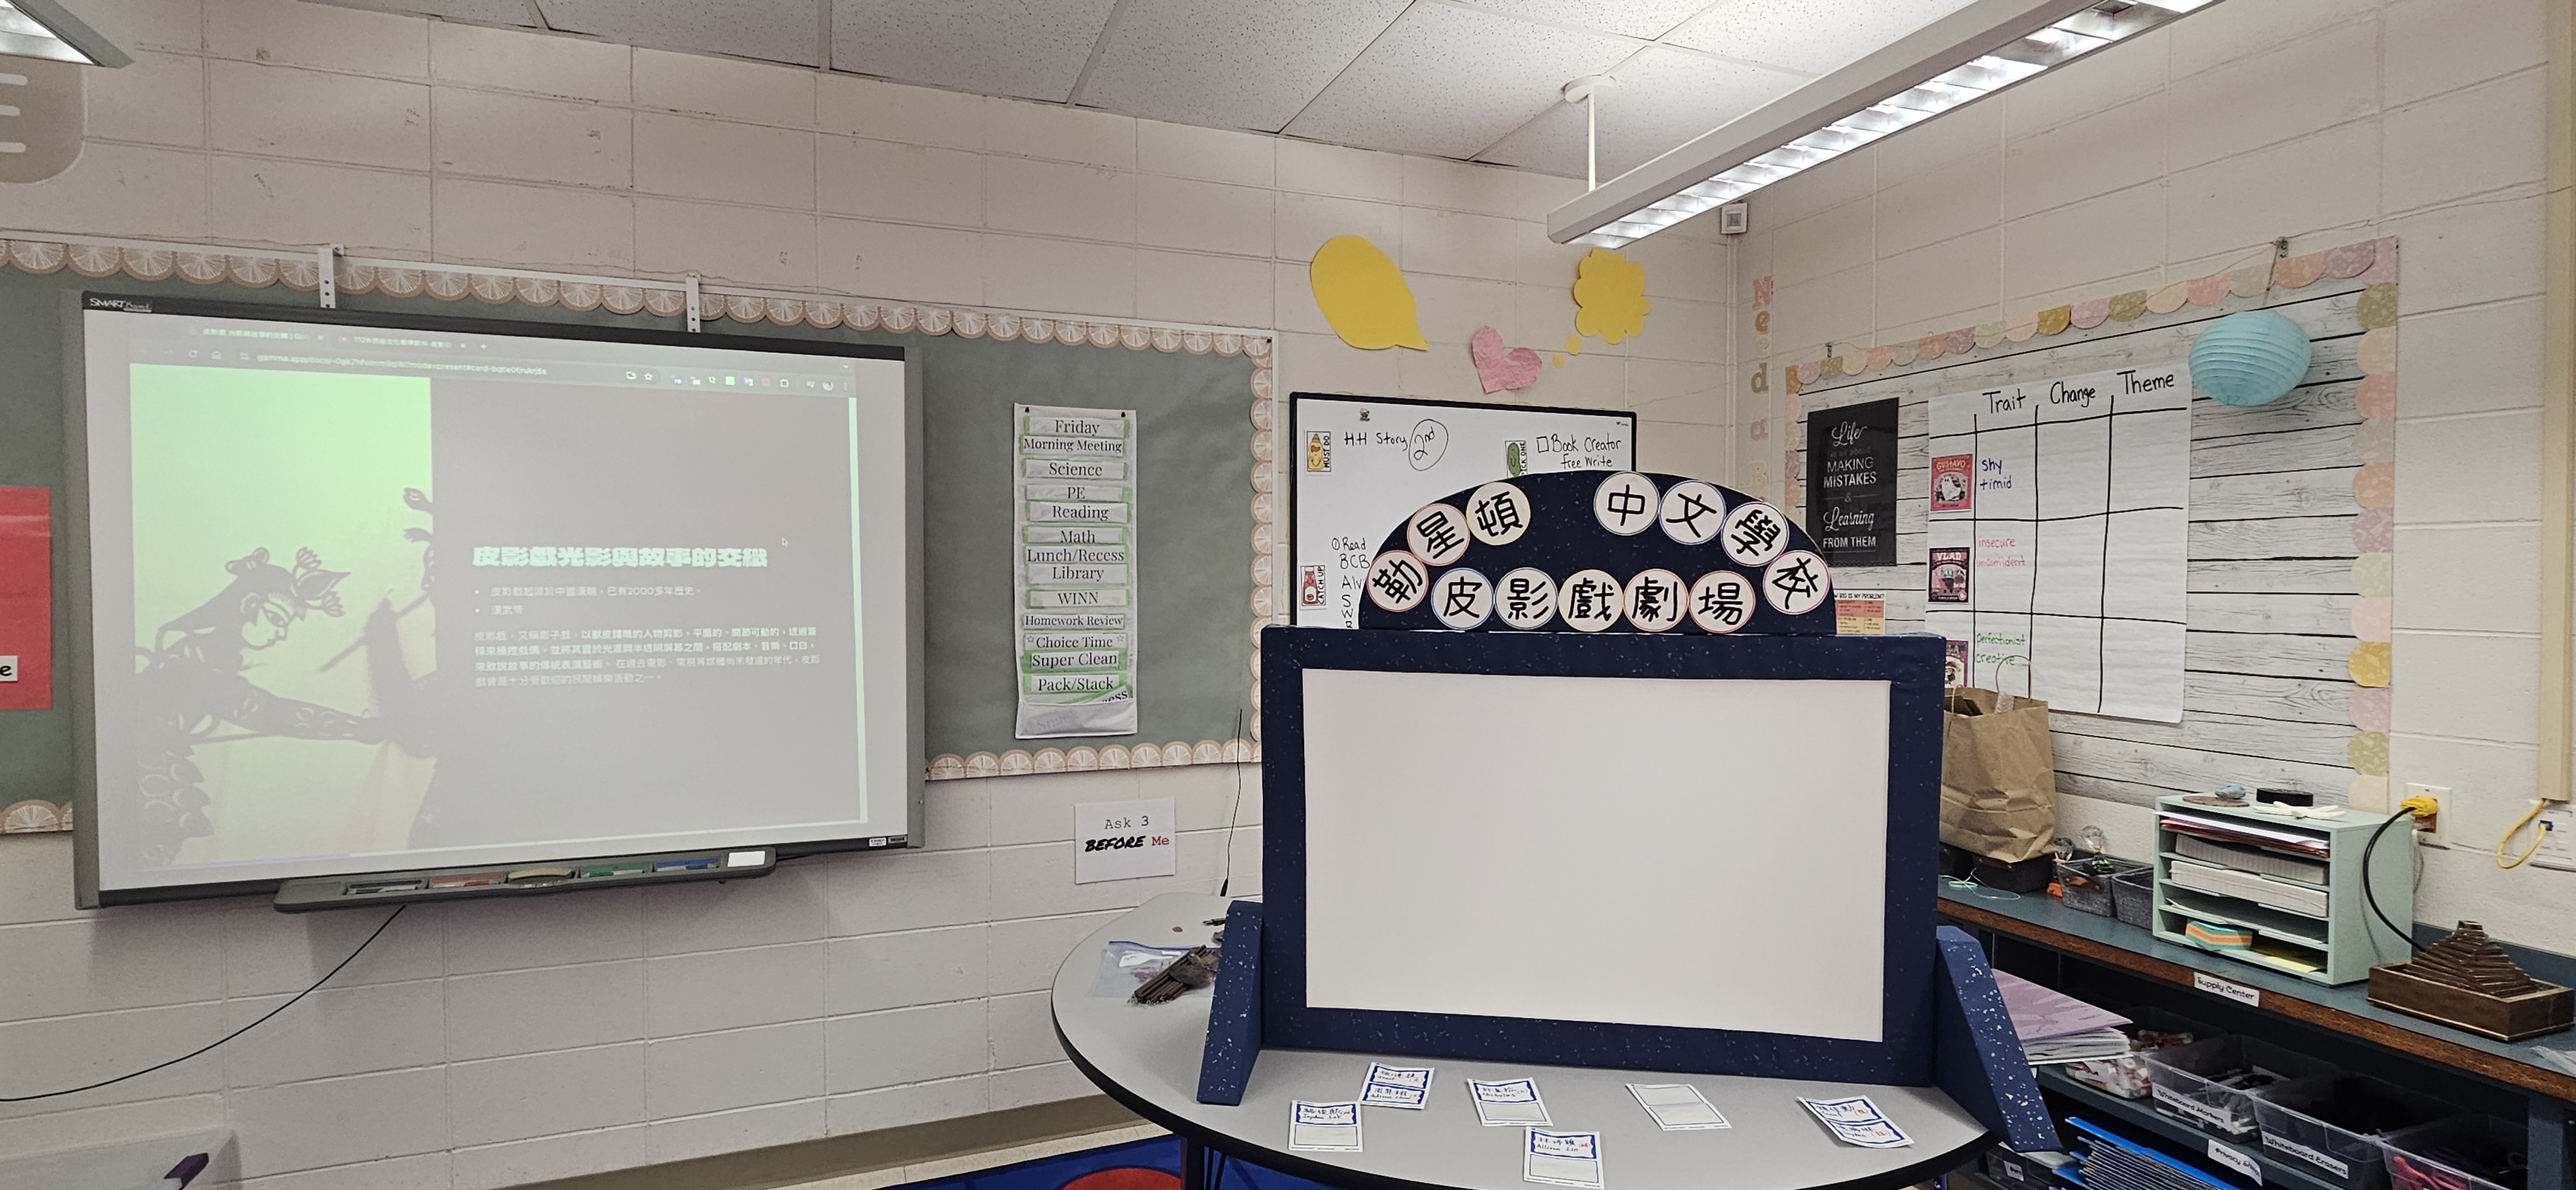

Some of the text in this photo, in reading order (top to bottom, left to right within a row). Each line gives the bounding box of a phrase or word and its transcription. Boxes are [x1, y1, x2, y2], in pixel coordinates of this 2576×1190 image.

[90, 298, 126, 308] SMART
[1982, 370, 2175, 414] Trait Change Theme
[1055, 419, 1100, 437] Friday
[1831, 420, 1868, 446] Life
[1024, 438, 1122, 453] Morning Meeting
[1323, 435, 1331, 446] DO
[1376, 431, 1408, 451] Story
[1413, 426, 1435, 460] 2nd
[1551, 432, 1622, 453] Book Creator
[1560, 453, 1613, 469] Free Write
[1827, 457, 1874, 472] MAKING
[1982, 458, 2002, 475] shy
[1049, 462, 1103, 476] Science
[1823, 471, 1877, 488] MISTAKES
[1980, 475, 2012, 490] timid
[1067, 487, 1086, 499] PE
[1844, 492, 1852, 502] &
[1052, 505, 1109, 521] Reading
[1823, 506, 1875, 531] Learning
[1060, 530, 1095, 543] Math
[1342, 536, 1366, 551] Read
[1823, 536, 1876, 548] FROM THEM
[1978, 536, 2016, 547] insecure
[1027, 549, 1124, 562] Lunch/Recess
[1340, 553, 1370, 569] BCB
[1936, 552, 1962, 561] VLAD
[1052, 566, 1104, 581] Library
[1057, 592, 1099, 605] WINN
[1443, 576, 1743, 625] 皮影戲劇場
[1025, 616, 1124, 626] Homework Review
[1036, 636, 1113, 648] Choice Time
[1976, 632, 2027, 647] perfectionist
[1032, 653, 1117, 669] Super Clean
[1976, 653, 2015, 665] creative
[1038, 677, 1114, 691] Pack/Stack
[1104, 816, 1149, 829] Ask 3
[1084, 835, 1170, 853] BEFORE Me
[2197, 976, 2255, 999] Supply Center
[2157, 1089, 2195, 1111] Whiteboard
[2264, 1136, 2347, 1175] Whiteboard Erasers
